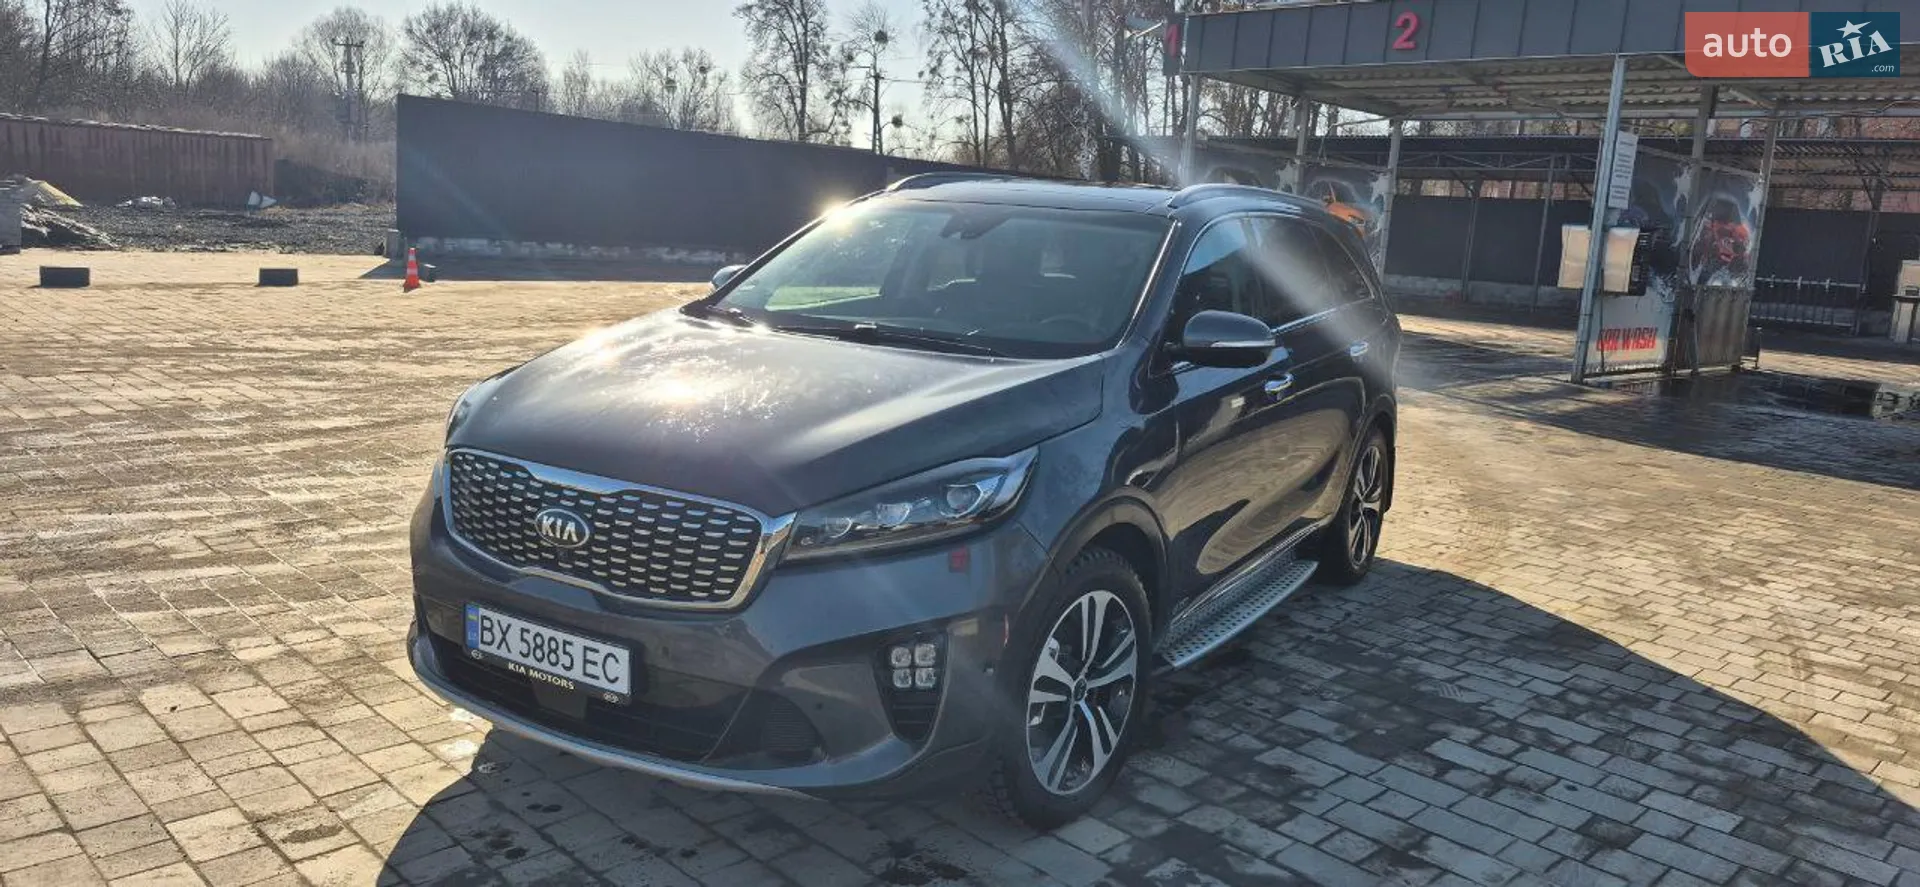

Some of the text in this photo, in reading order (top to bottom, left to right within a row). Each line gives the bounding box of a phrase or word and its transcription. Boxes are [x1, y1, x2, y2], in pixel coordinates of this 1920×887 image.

[1165, 23, 1180, 57] 1
[1392, 11, 1421, 49] 2
[1622, 327, 1658, 350] WASH
[541, 515, 578, 542] KIA
[480, 615, 620, 684] BX 5885 EC
[508, 662, 575, 690] KIA MOTORS
